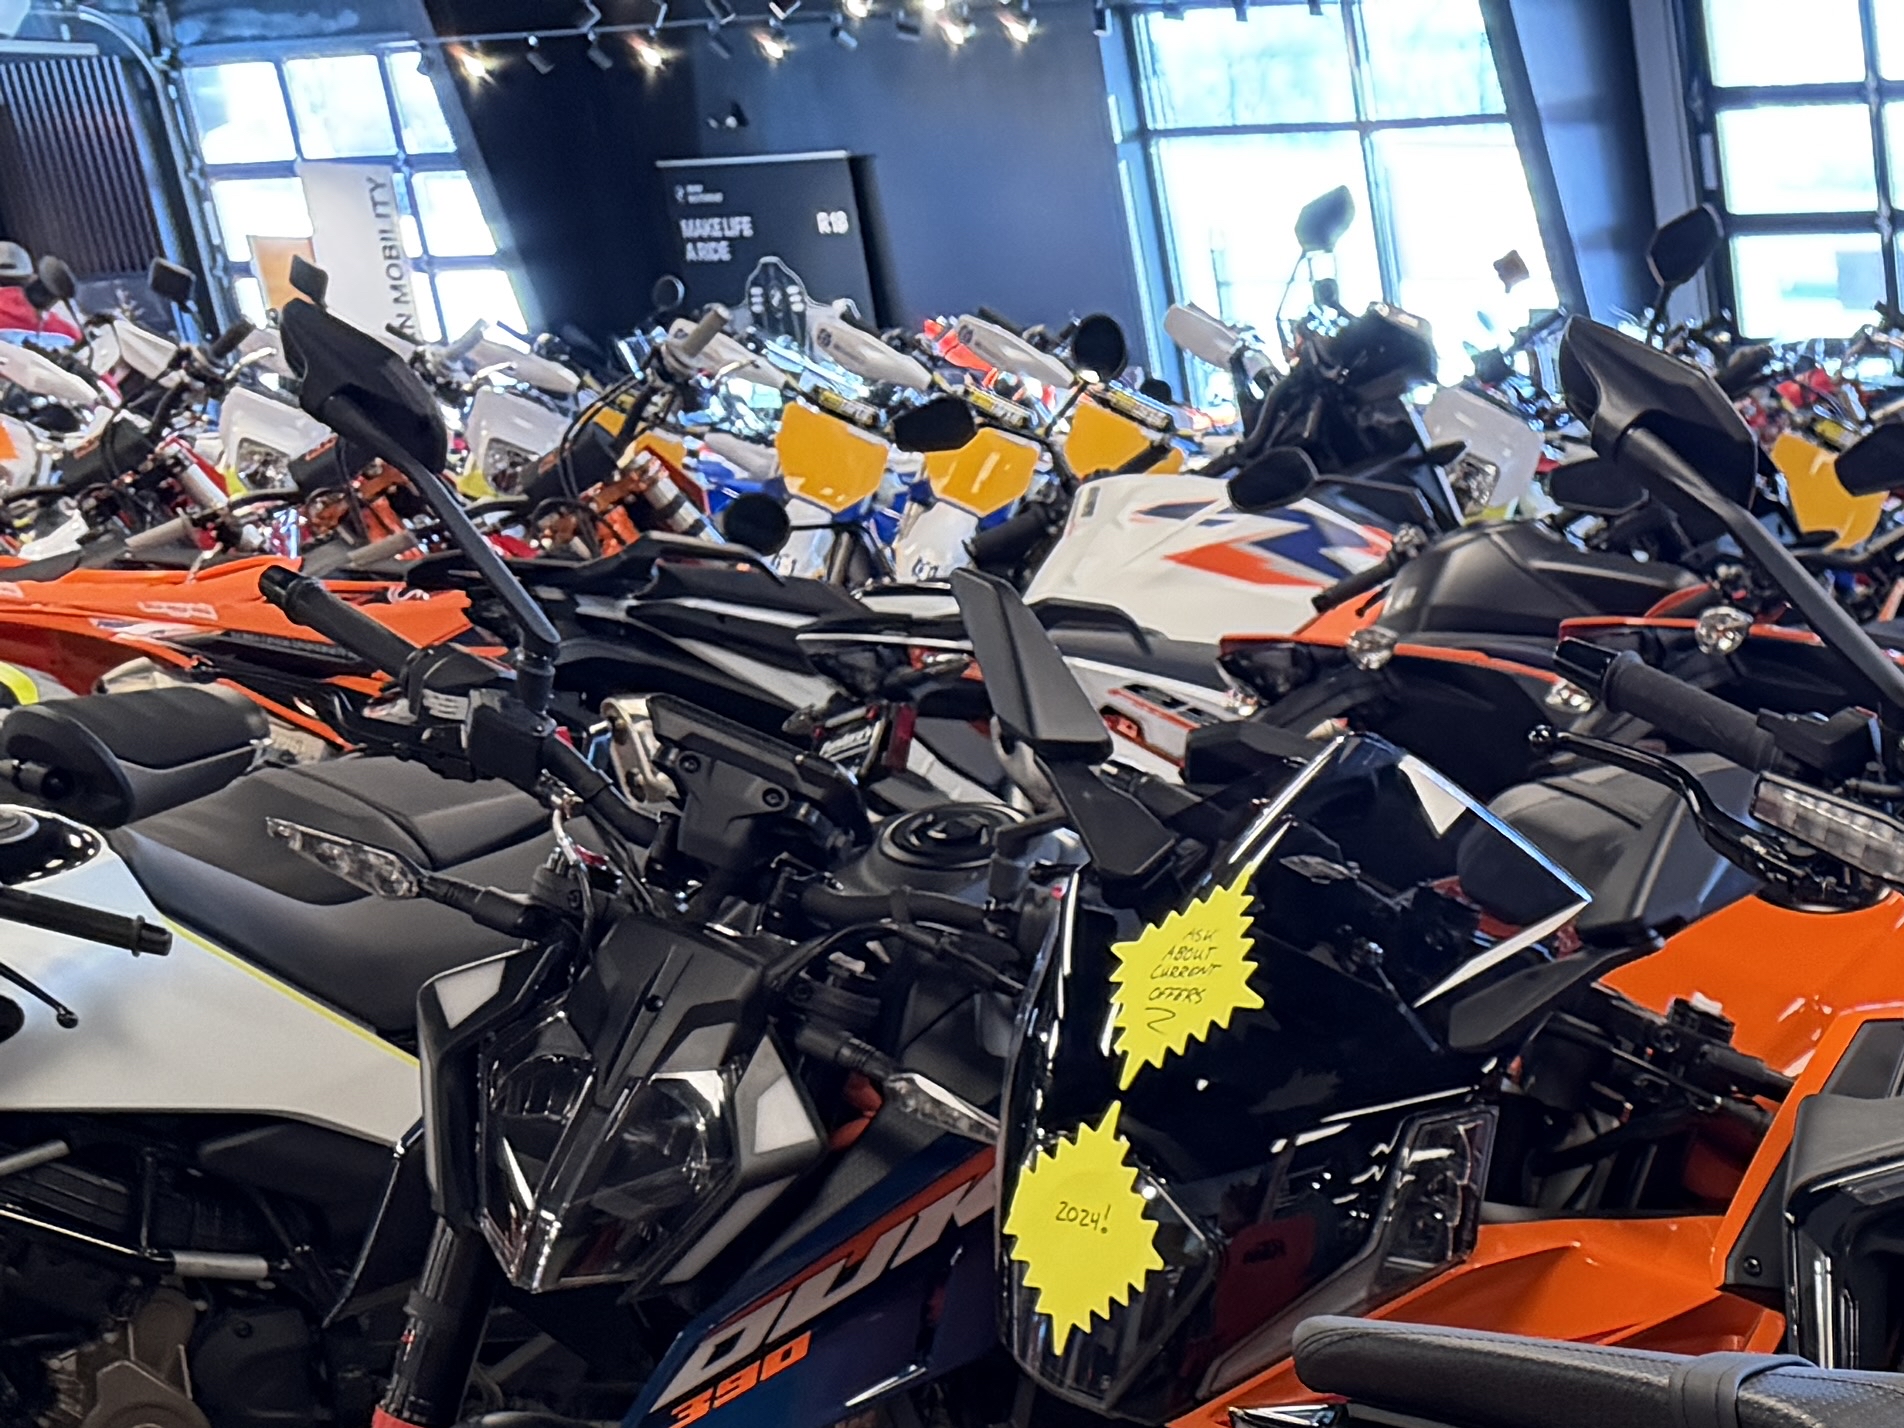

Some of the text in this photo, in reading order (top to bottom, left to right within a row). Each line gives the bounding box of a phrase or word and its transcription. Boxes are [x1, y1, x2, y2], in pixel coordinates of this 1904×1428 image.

[366, 176, 409, 305] MOBILITY
[1161, 946, 1218, 962] ABOUT
[1150, 963, 1222, 980] CURRENT
[1148, 986, 1206, 1004] OFFERS
[1056, 1200, 1111, 1234] 2024!
[649, 1166, 996, 1412] DUK
